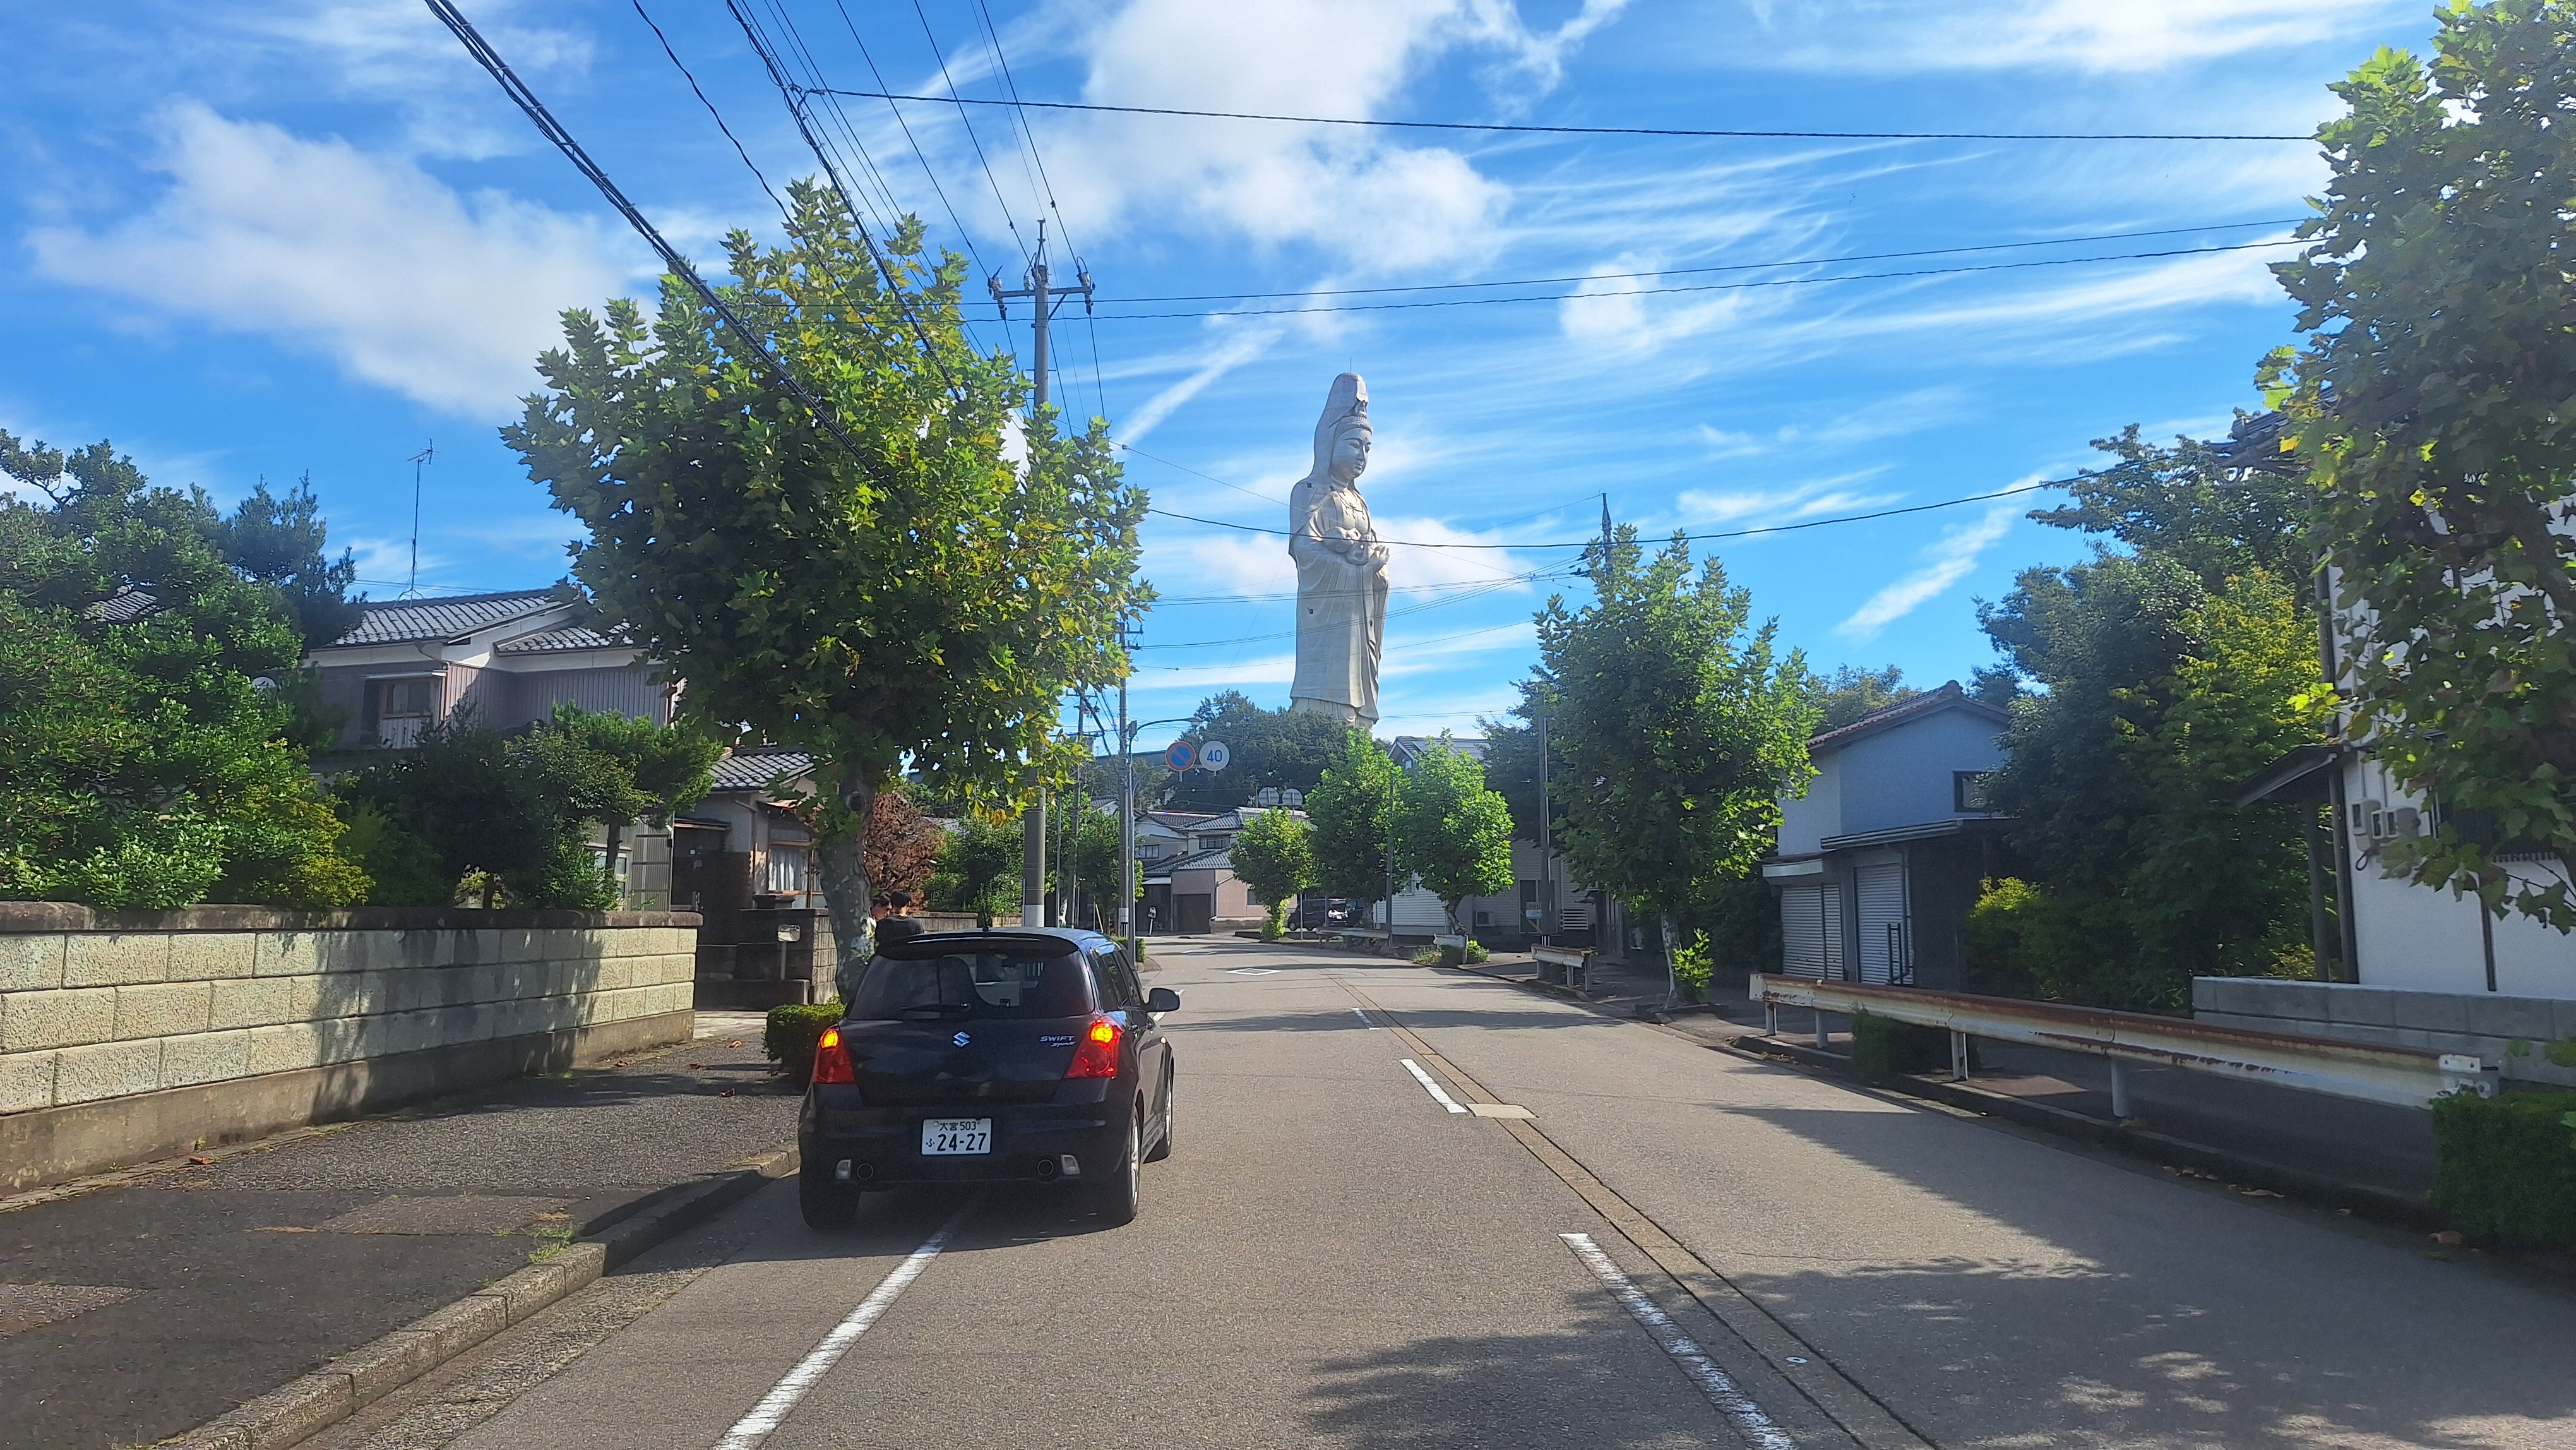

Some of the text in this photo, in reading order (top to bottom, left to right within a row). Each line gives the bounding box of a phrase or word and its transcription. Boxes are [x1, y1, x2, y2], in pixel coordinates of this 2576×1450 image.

[1207, 750, 1222, 762] 40
[939, 1121, 977, 1131] 大宮 503
[926, 1133, 987, 1151] ふ 24-27
